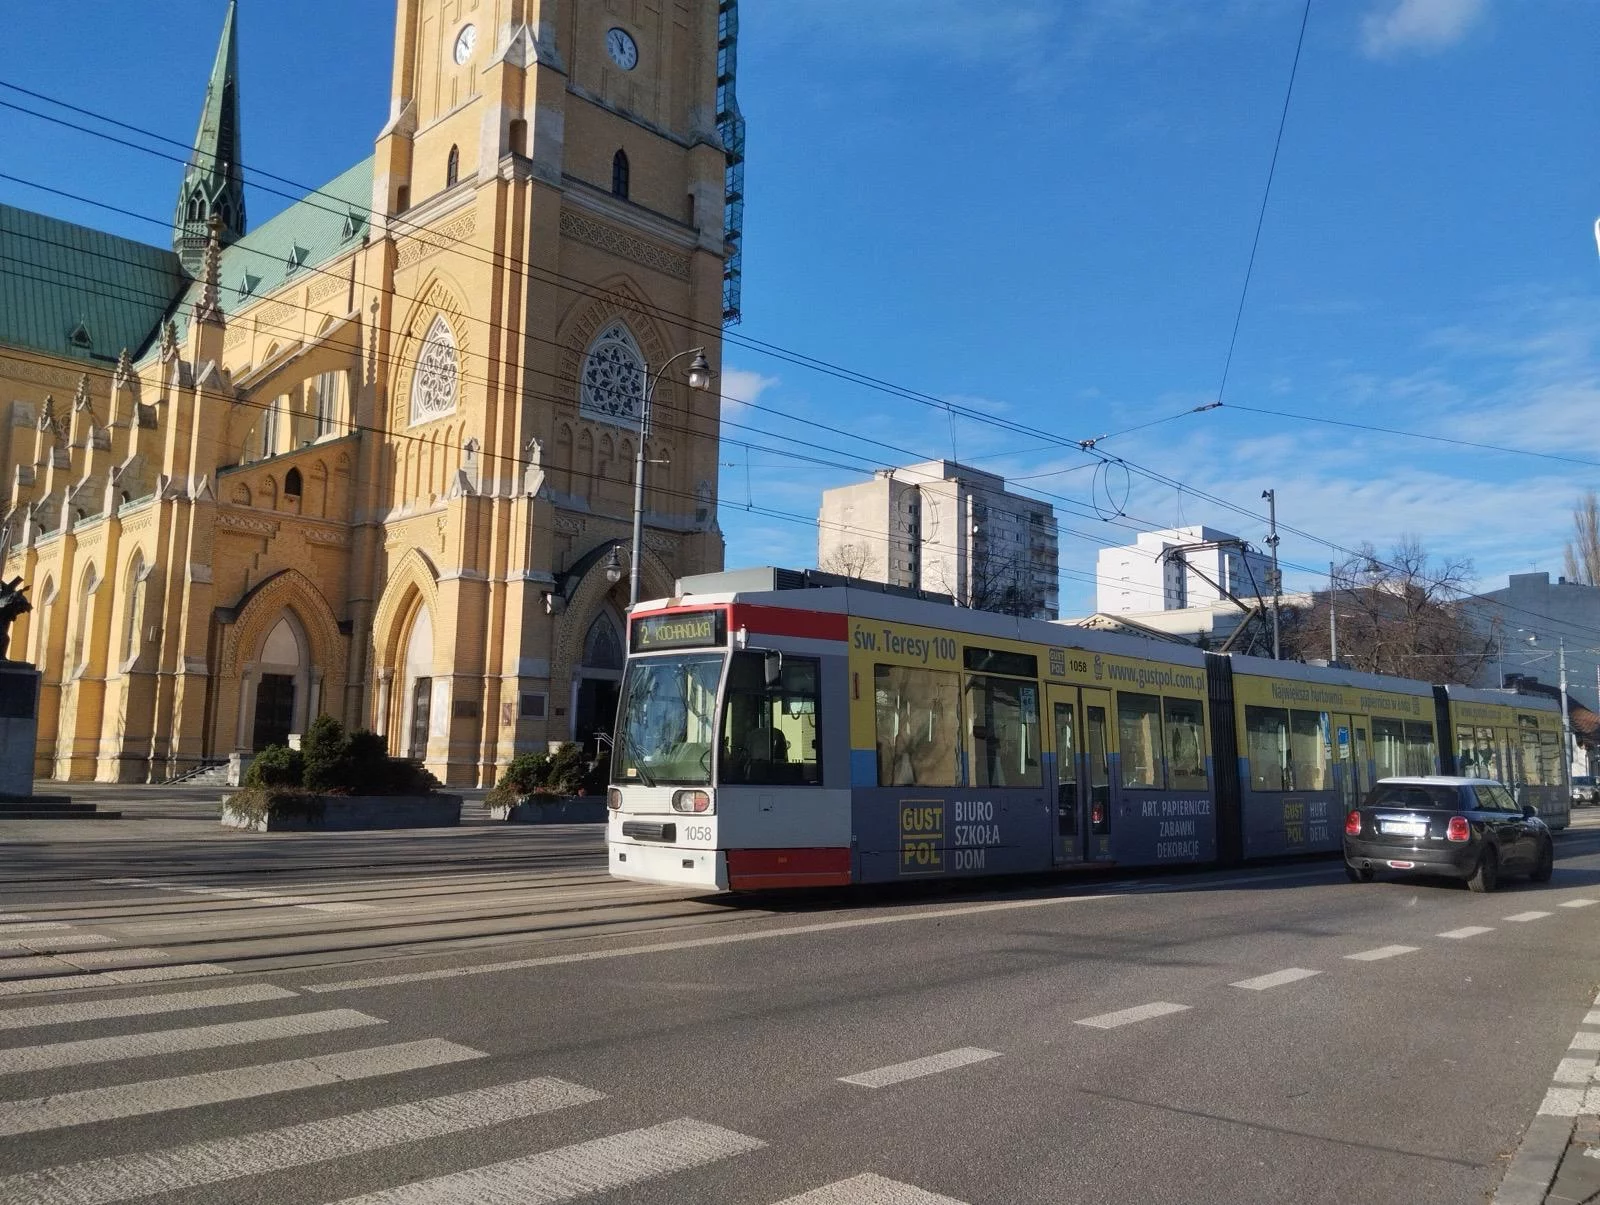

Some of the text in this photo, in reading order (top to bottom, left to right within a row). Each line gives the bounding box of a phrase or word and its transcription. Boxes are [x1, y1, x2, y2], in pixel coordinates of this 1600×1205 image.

[641, 621, 711, 644] 2 KOCHANÓWKA
[854, 624, 957, 664] św. Teresy 100
[1069, 660, 1088, 673] 1058
[1107, 664, 1205, 695] www.gustpol.com.pl
[955, 801, 994, 822] BIURO
[1141, 800, 1211, 817] ART. PAPIERNICZE
[902, 808, 943, 831] GUST
[1160, 821, 1195, 837] ZABAWKI
[684, 826, 712, 841] 1058
[955, 825, 1000, 846] SZKOŁA
[904, 842, 940, 865] POL
[955, 849, 985, 870] DOM
[1157, 840, 1200, 860] DEKORACJE
